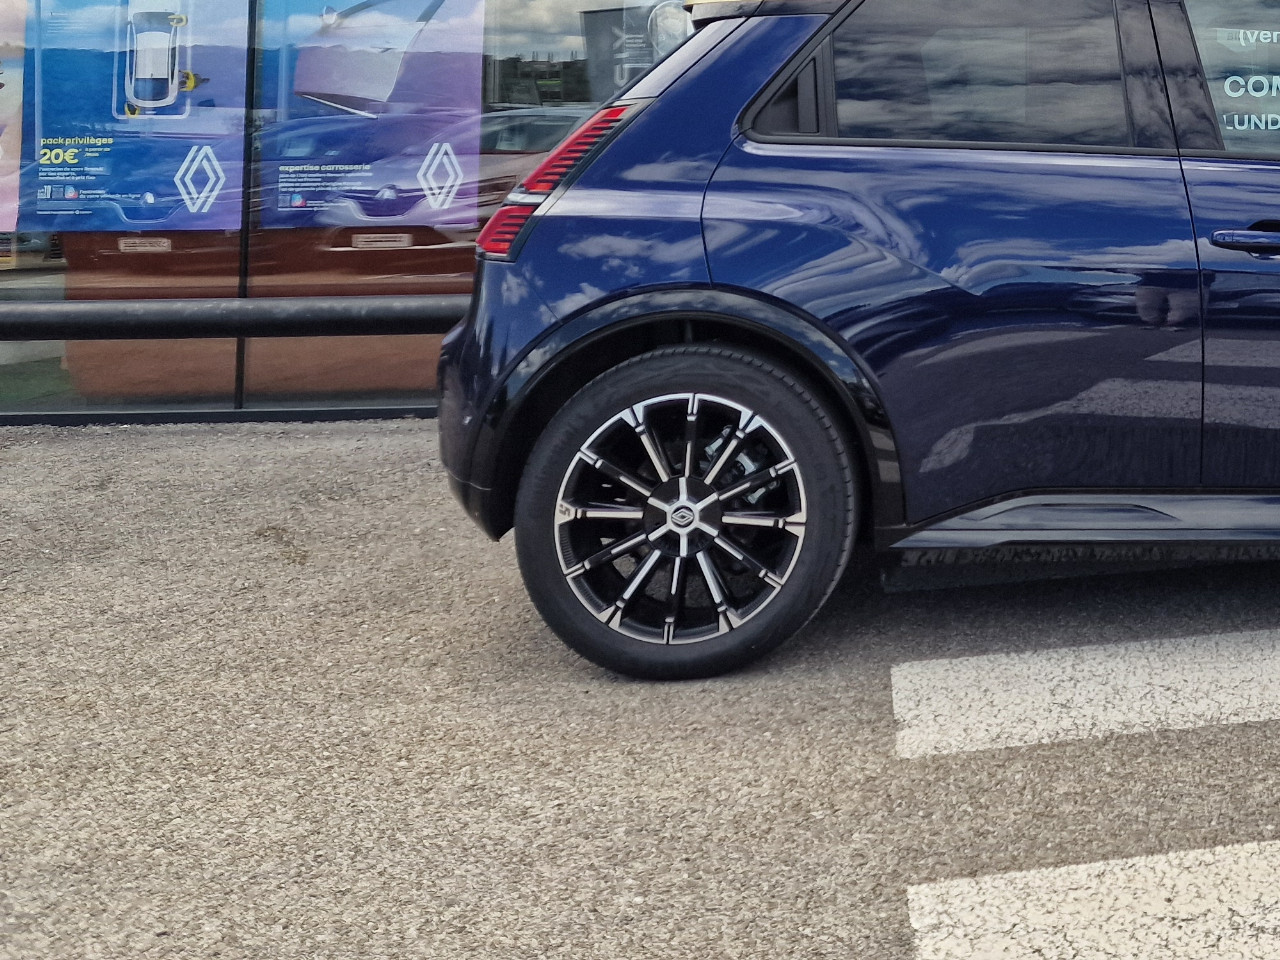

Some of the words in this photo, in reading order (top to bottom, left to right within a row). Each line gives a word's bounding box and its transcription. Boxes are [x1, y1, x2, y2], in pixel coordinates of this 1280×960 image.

[40, 137, 64, 147] pack
[65, 136, 114, 146] privilèges
[279, 164, 320, 173] expertise
[321, 163, 371, 172] carrosserie
